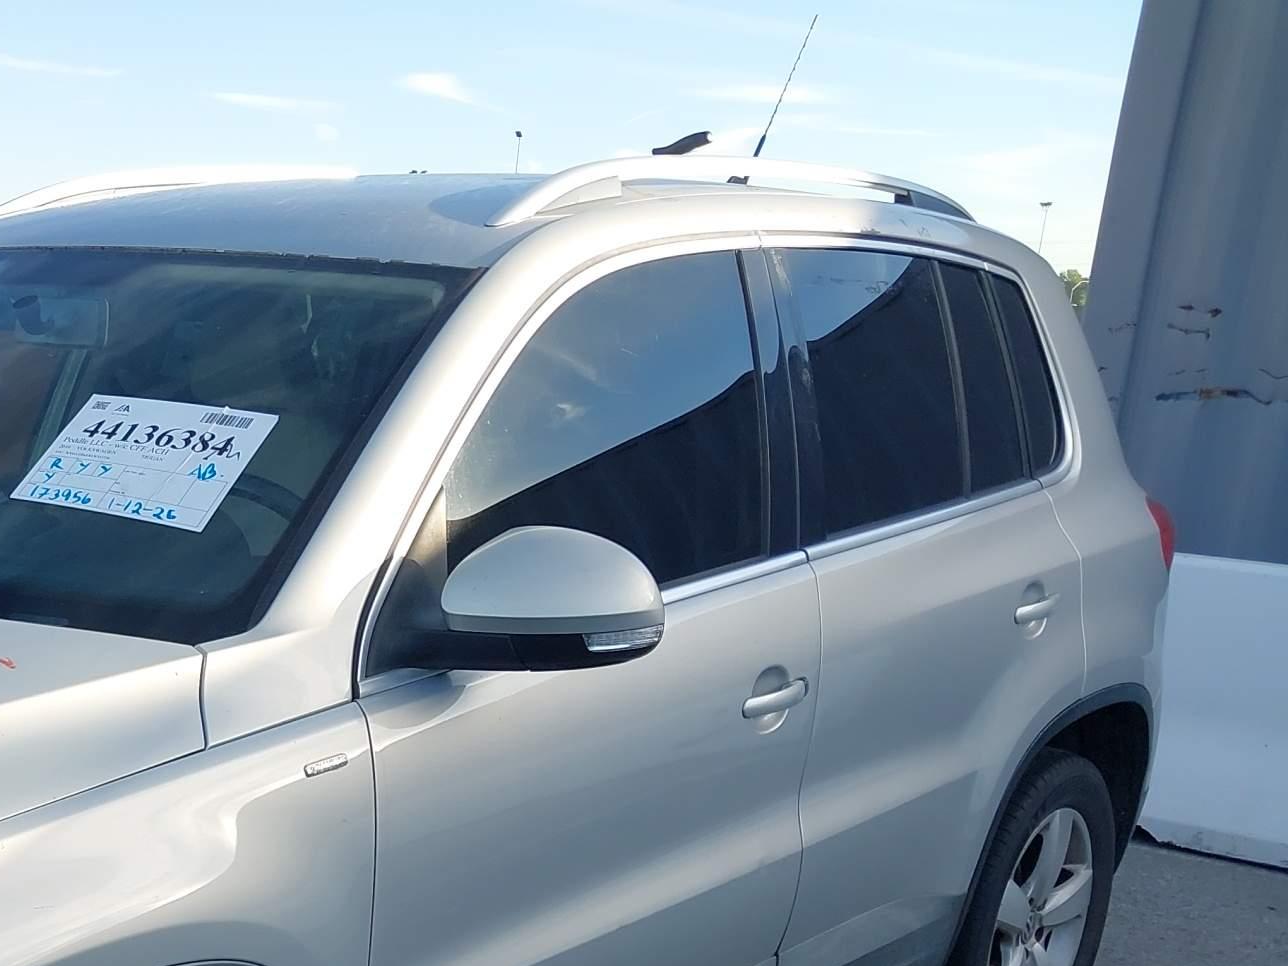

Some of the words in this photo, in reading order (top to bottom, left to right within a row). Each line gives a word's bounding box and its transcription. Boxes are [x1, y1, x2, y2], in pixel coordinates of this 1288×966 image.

[82, 419, 235, 457] 44136384
[50, 457, 63, 470] R
[29, 484, 92, 505] 173956
[108, 497, 177, 520] 1-12-26
